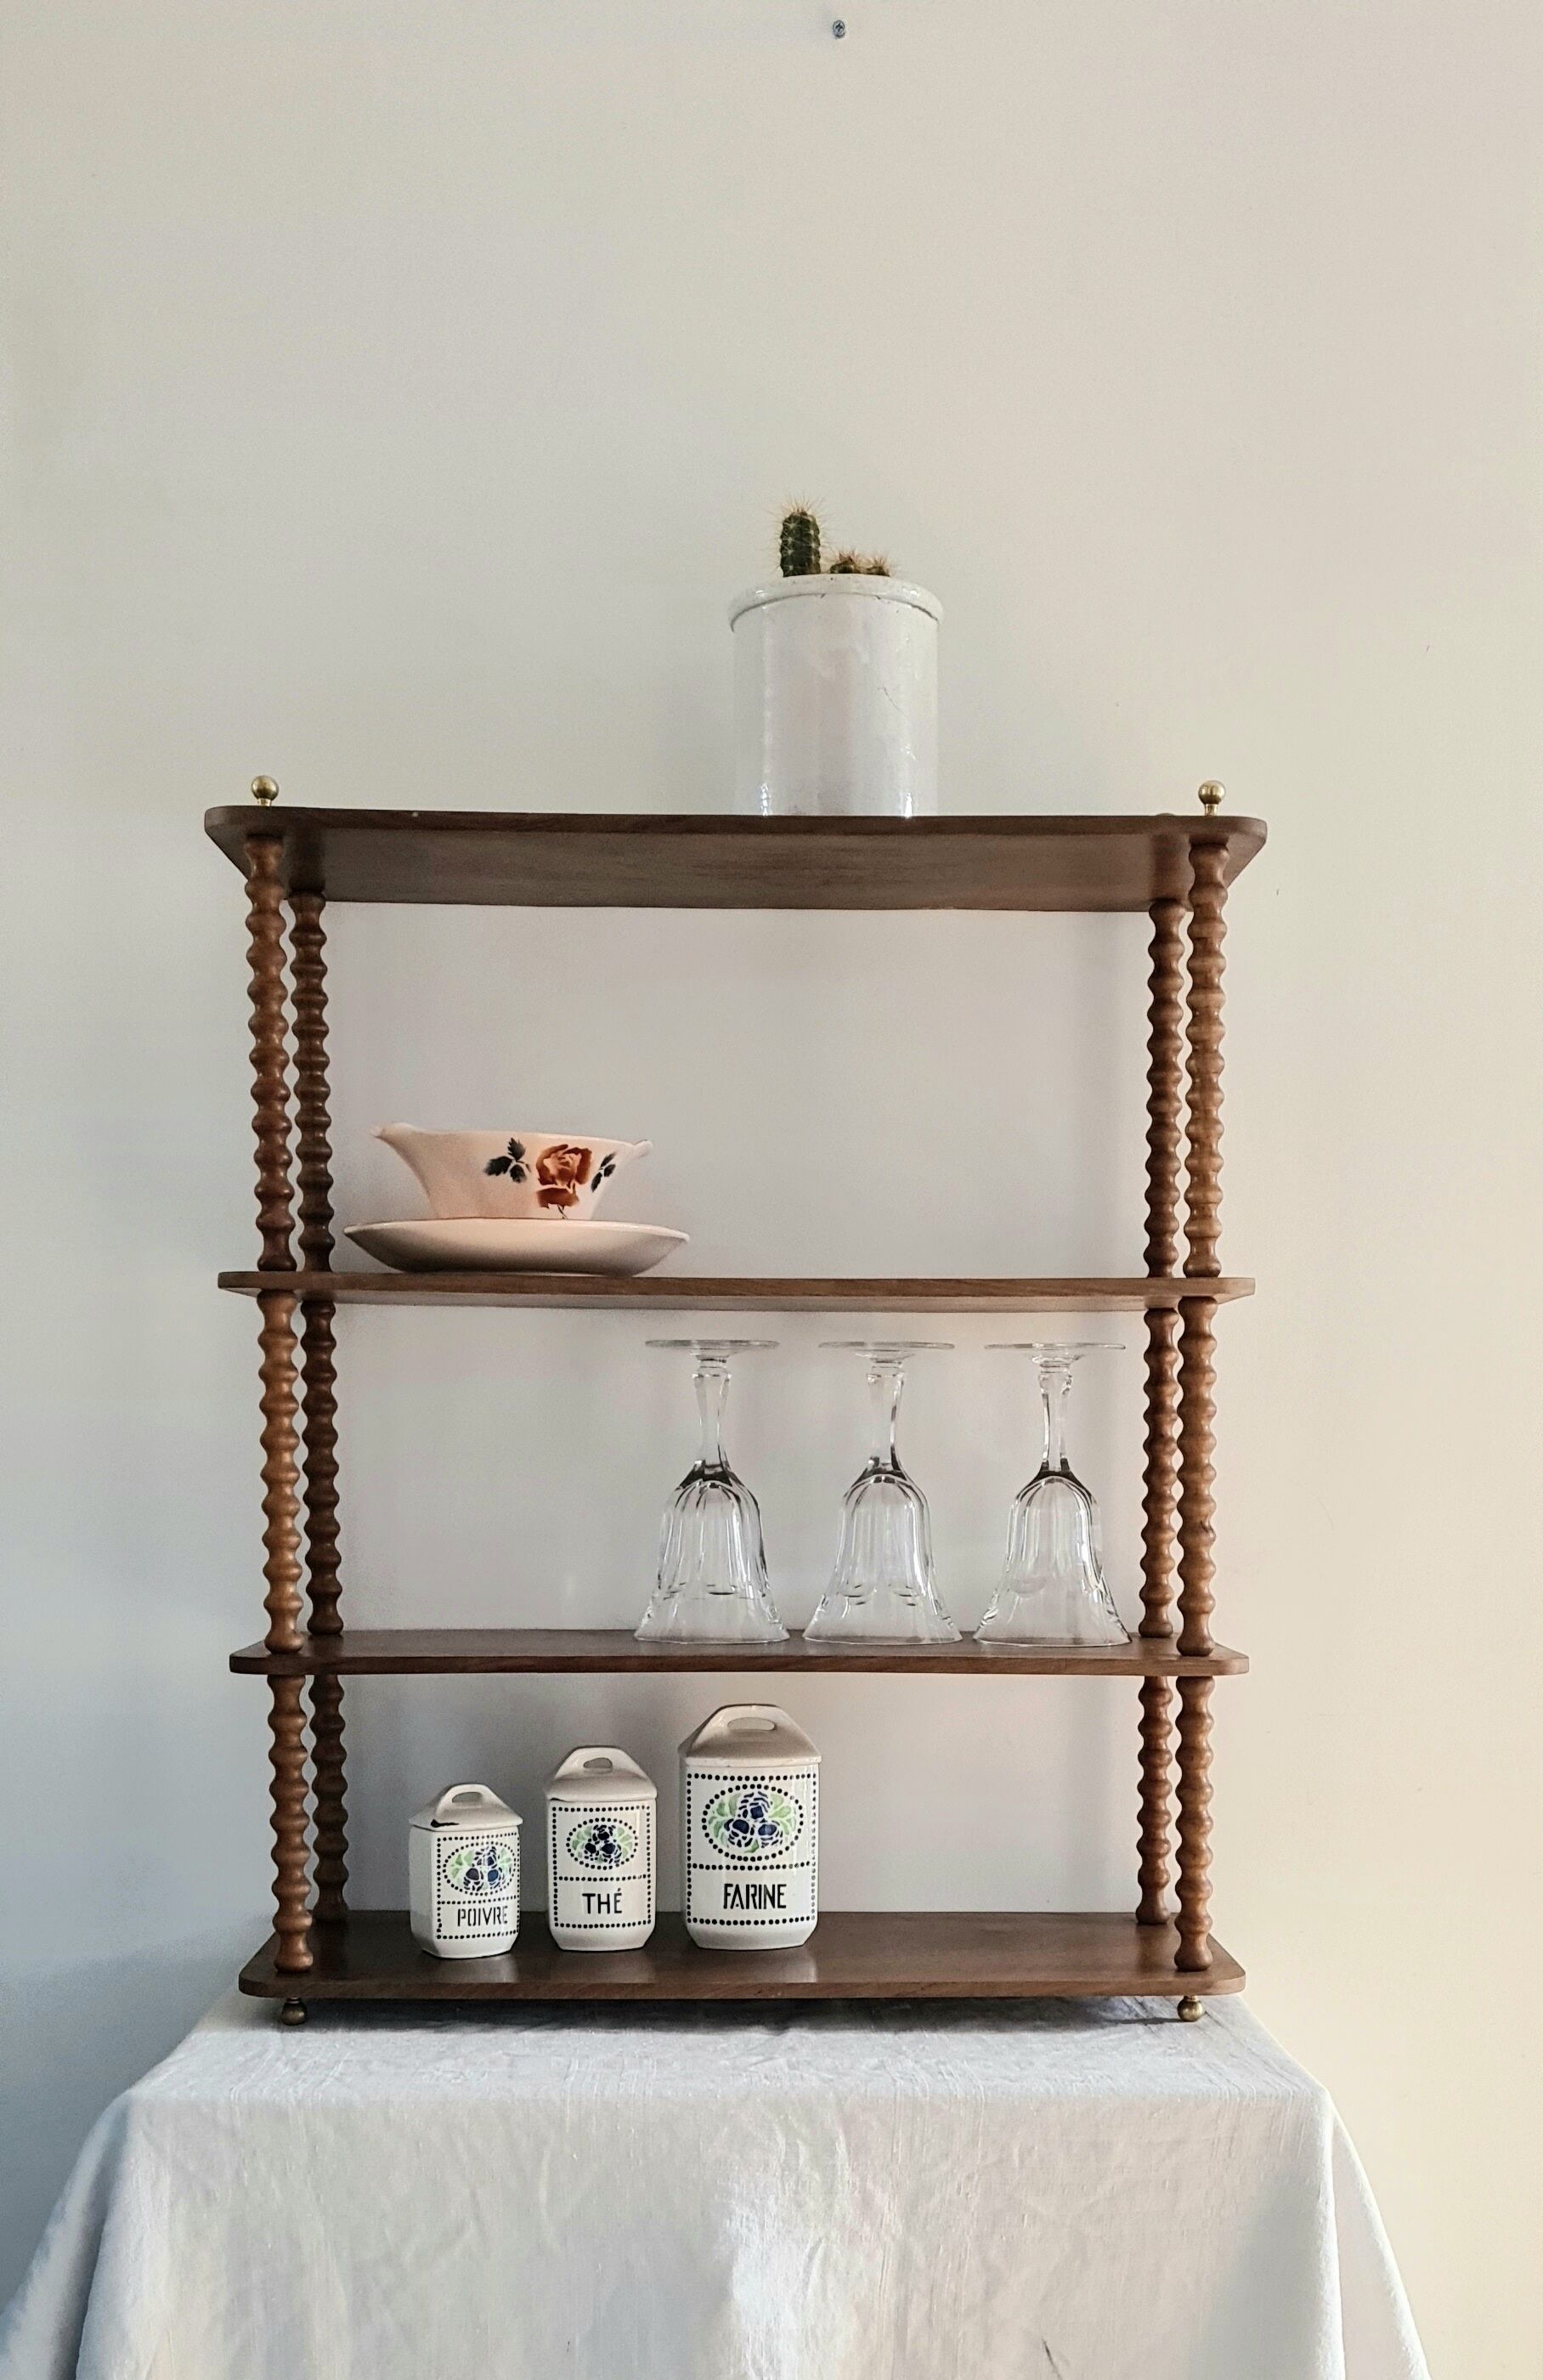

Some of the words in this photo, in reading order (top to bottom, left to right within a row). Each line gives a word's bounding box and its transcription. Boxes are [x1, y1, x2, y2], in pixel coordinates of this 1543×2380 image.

[582, 1888, 622, 1914] THÉ
[723, 1884, 787, 1909] FARINE
[457, 1905, 508, 1926] POIVRE
